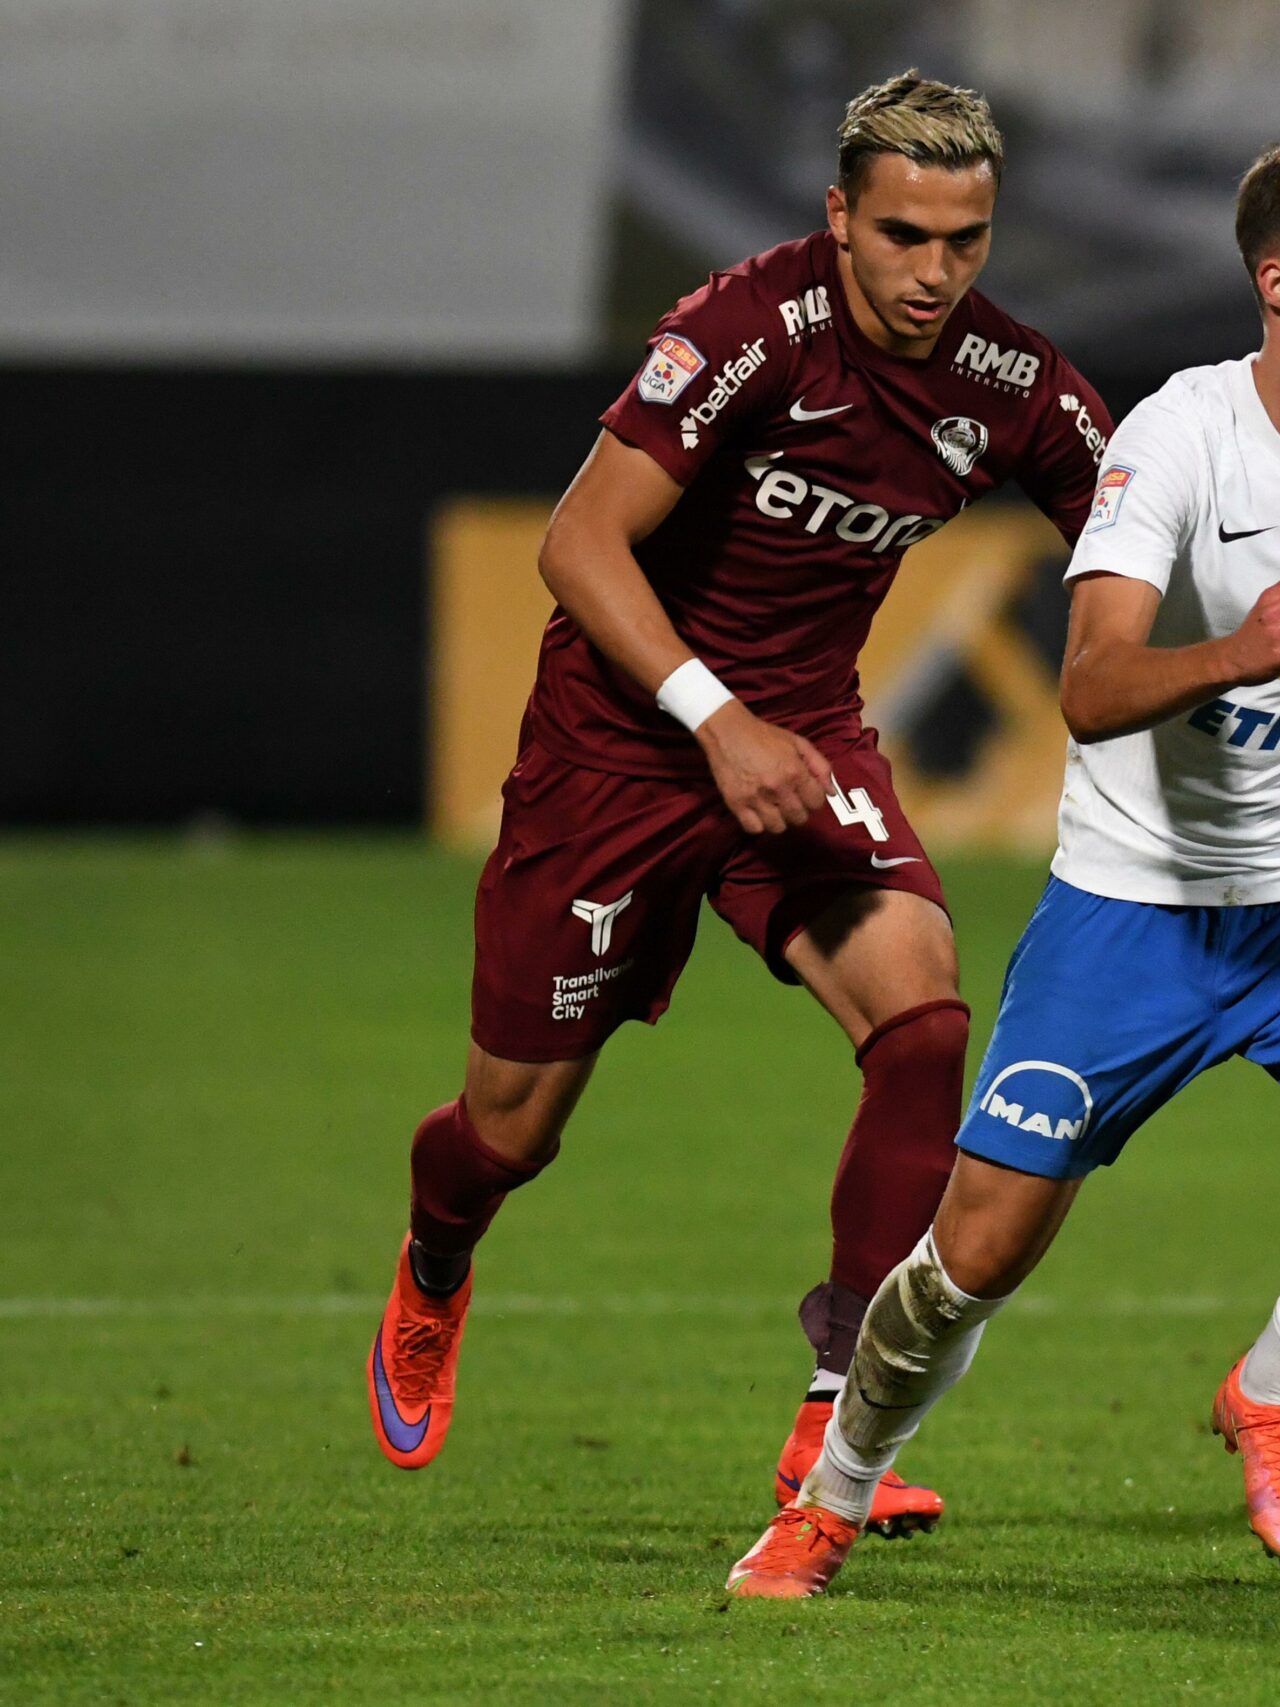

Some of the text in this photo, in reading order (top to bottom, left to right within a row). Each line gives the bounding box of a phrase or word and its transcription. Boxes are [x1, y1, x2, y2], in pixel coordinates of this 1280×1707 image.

[642, 373, 665, 393] LIGA
[689, 338, 767, 425] betfair
[950, 364, 1030, 398] INTERAUTO
[954, 333, 1040, 387] RMB
[1075, 405, 1107, 466] bet
[826, 772, 890, 842] 4
[551, 1004, 585, 1020] City
[552, 984, 599, 1006] Smart
[987, 1093, 1083, 1140] MAN
